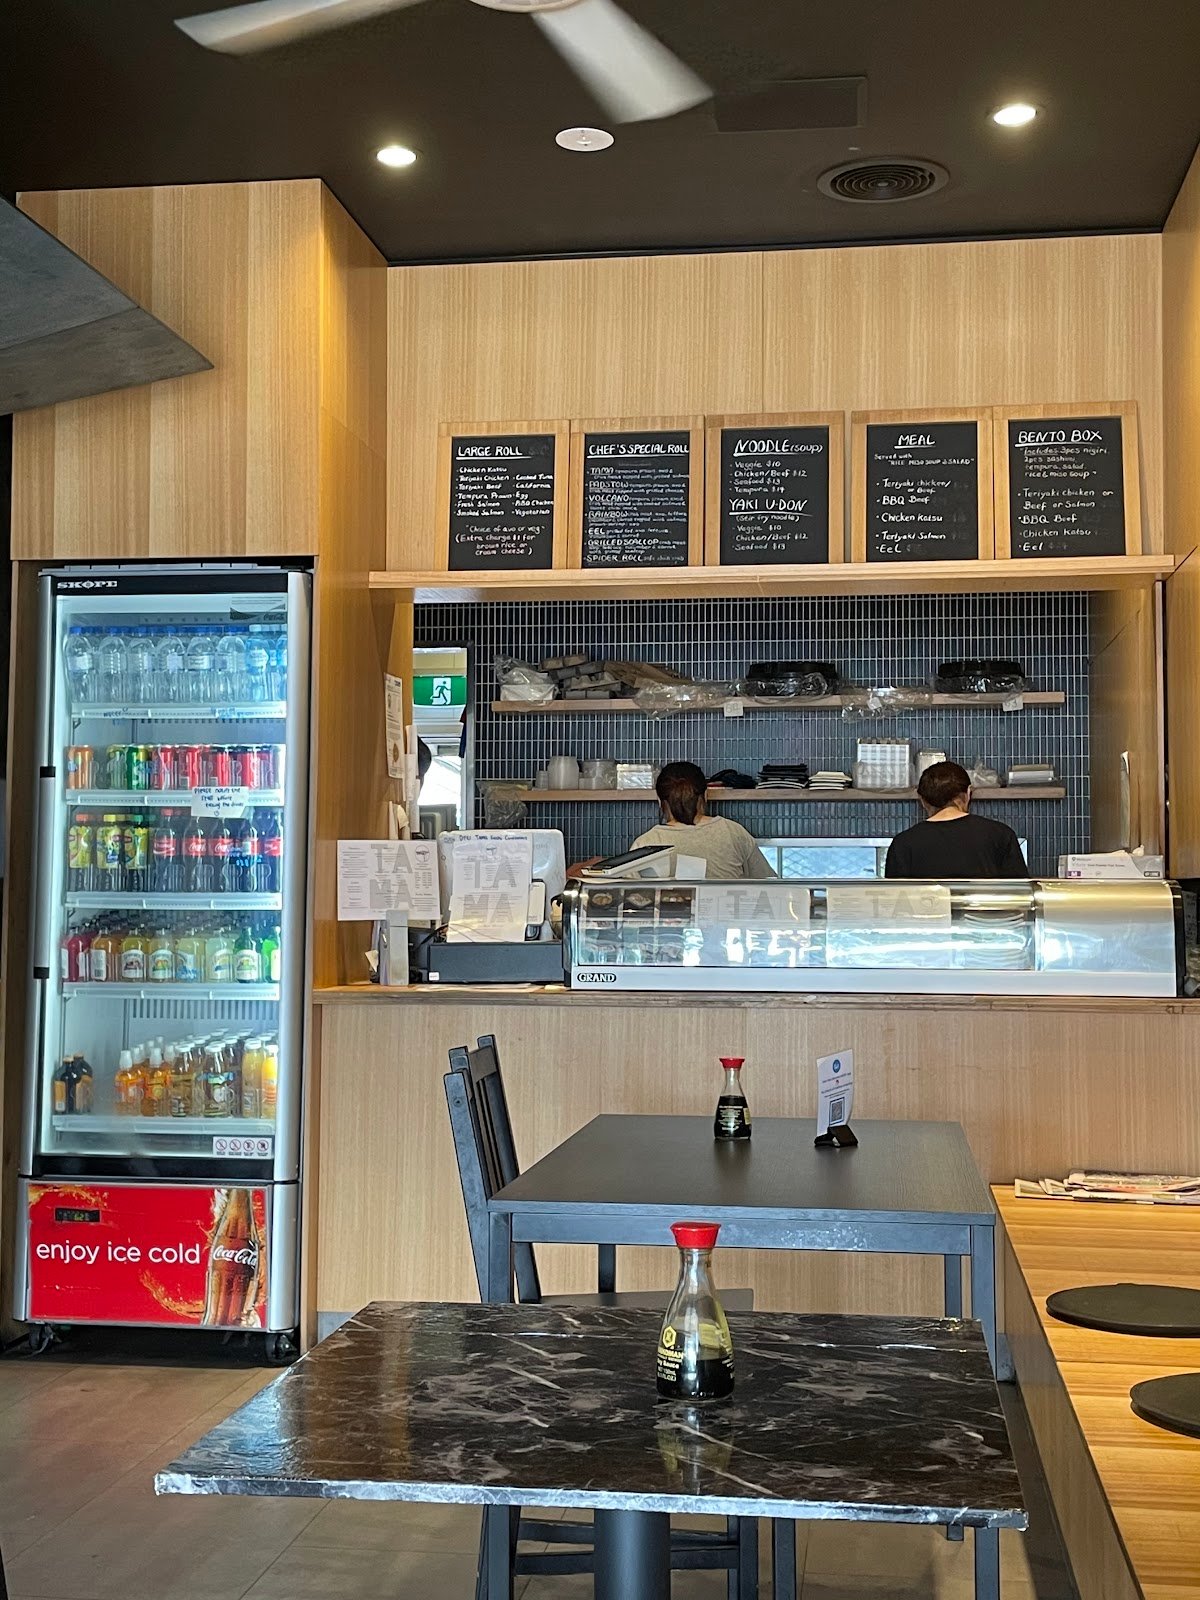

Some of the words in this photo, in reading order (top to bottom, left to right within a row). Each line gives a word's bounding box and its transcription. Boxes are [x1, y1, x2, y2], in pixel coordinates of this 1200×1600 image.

[898, 434, 936, 446] MEAL
[1018, 430, 1066, 443] BENTO
[1071, 429, 1103, 442] BOX
[458, 446, 491, 456] LARGE
[495, 446, 523, 456] ROLL
[589, 444, 626, 455] CHEF'S
[627, 444, 666, 454] SPECIAL
[668, 444, 690, 453] ROLL
[735, 461, 762, 471] Veggie
[766, 460, 781, 468] $10
[733, 477, 765, 485] Seafood
[516, 491, 529, 500] Egg
[734, 486, 769, 495] Tempura
[1023, 488, 1059, 500] Teriyaki
[1062, 488, 1095, 497] chicken
[589, 494, 630, 502] VOLCANO
[882, 495, 905, 505] BBQ
[729, 499, 758, 511] YAKI
[1023, 500, 1047, 511] Beef
[1065, 500, 1096, 508] Salmon
[588, 511, 628, 519] RAINBOW
[881, 512, 915, 522] Chicken
[917, 513, 943, 522] Katsu
[1020, 514, 1049, 524] BBQ
[1053, 513, 1078, 523] Beef
[588, 527, 605, 535] EEL
[737, 525, 762, 534] Veggie
[769, 524, 782, 532] $10
[1023, 529, 1059, 538] Chicken
[1063, 528, 1091, 536] Katsu
[881, 530, 916, 542] Teriyaki
[917, 532, 946, 540] Salmon
[734, 543, 768, 551] Seafood
[1023, 542, 1044, 551] Eel
[586, 554, 618, 562] SPIDER
[622, 554, 644, 562] ROLL
[57, 580, 118, 589] SKOPE
[578, 973, 615, 982] GRAND
[36, 1240, 100, 1264] enjoy
[107, 1241, 141, 1262] ice
[148, 1242, 200, 1264] cold
[213, 1245, 258, 1268] Coca-Cola
